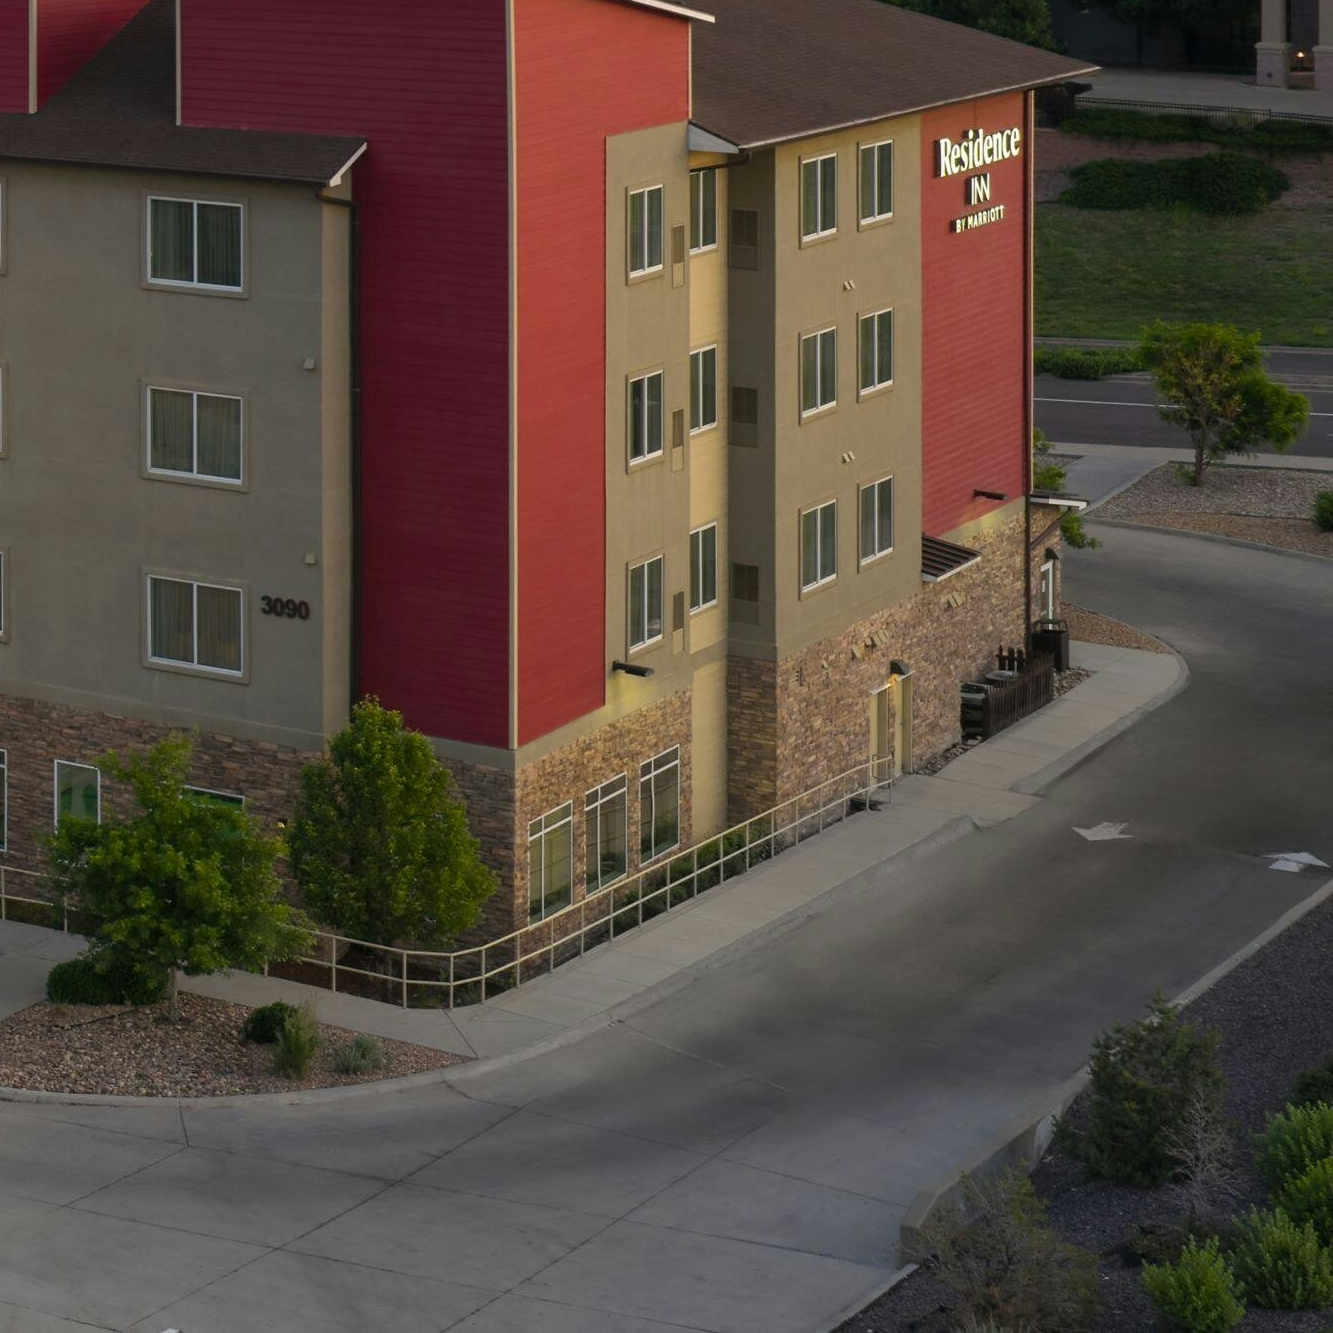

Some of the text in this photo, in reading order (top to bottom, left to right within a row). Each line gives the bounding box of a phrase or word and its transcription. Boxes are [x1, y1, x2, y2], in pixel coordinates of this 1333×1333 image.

[940, 127, 1021, 177] Residence
[971, 173, 990, 205] INN
[956, 205, 1004, 233] BY MARRIOTT
[261, 595, 310, 620] 3090
